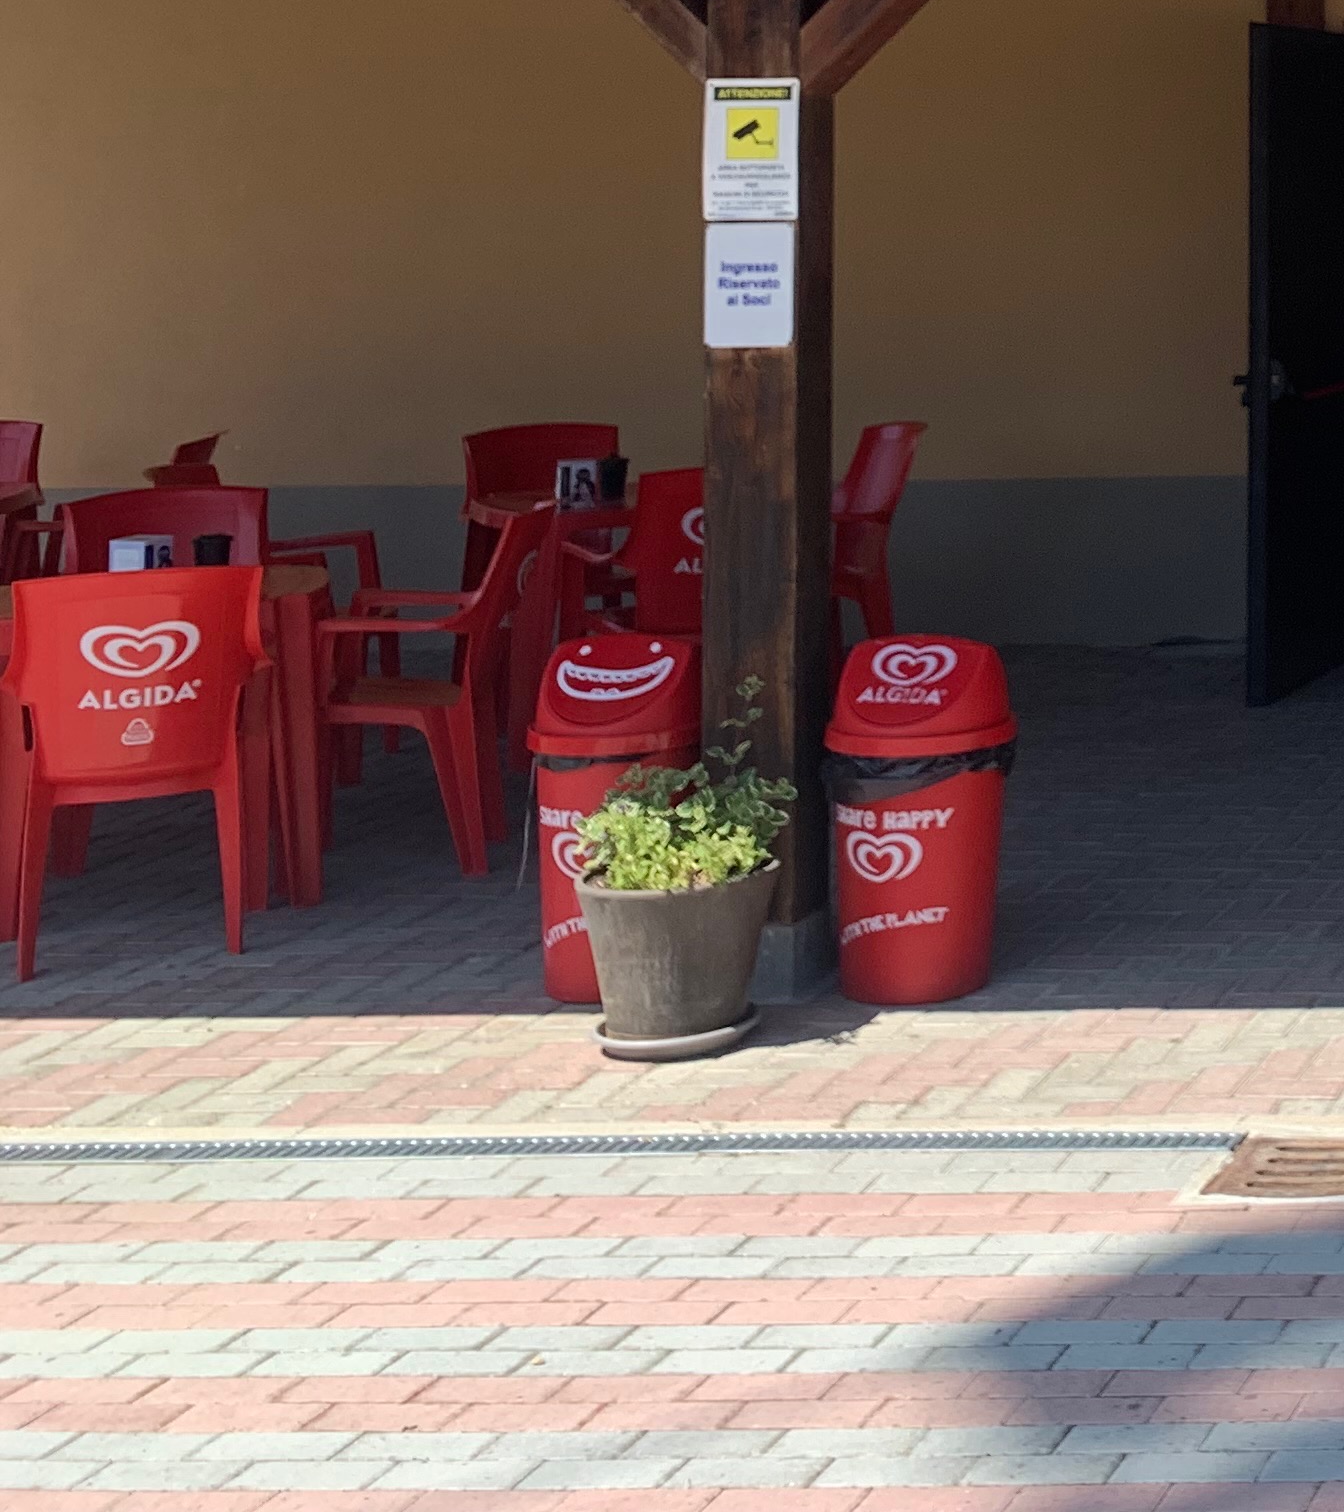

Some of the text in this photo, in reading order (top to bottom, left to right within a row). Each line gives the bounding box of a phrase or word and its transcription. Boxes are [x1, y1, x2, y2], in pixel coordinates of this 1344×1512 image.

[720, 261, 778, 276] Ingresso
[718, 277, 780, 290] Riservato
[726, 292, 772, 307] ai Soci
[77, 681, 198, 710] ALGIDA
